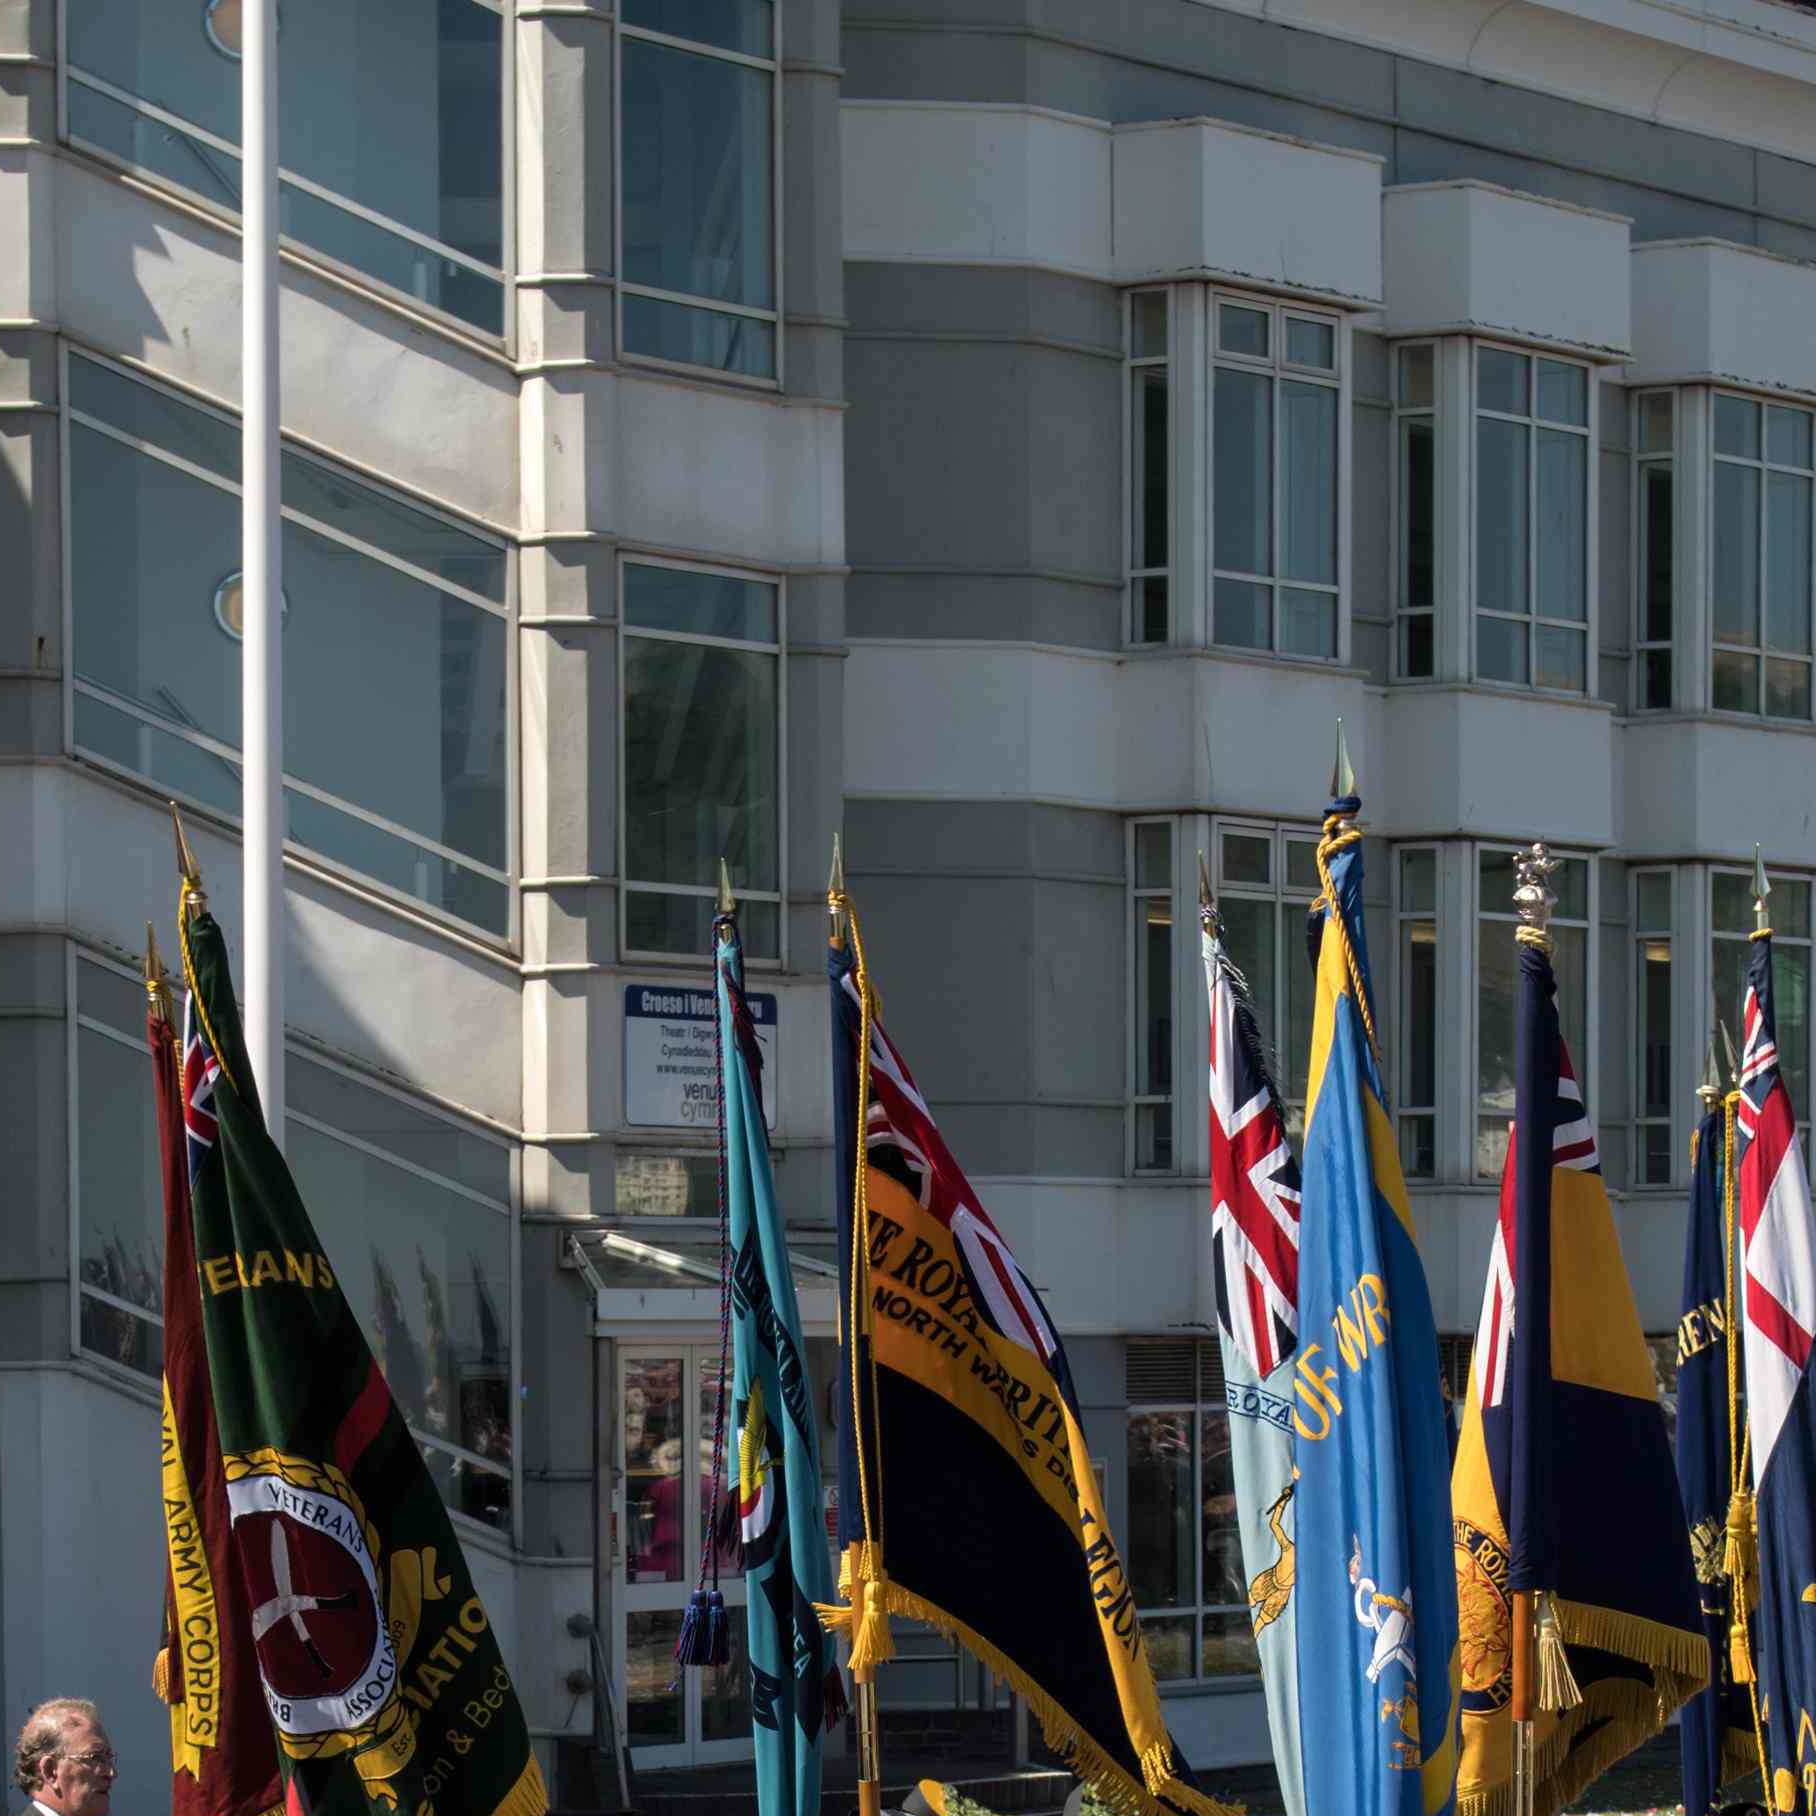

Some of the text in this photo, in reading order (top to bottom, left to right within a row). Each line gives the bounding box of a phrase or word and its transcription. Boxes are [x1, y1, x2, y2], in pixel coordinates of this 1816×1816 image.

[641, 989, 683, 1015] Croeso
[684, 993, 689, 1014] i
[871, 1286, 969, 1360] NORTH
[162, 1497, 210, 1596] ARMY
[266, 1482, 365, 1554] VETERANS
[183, 1615, 214, 1738] CORPS
